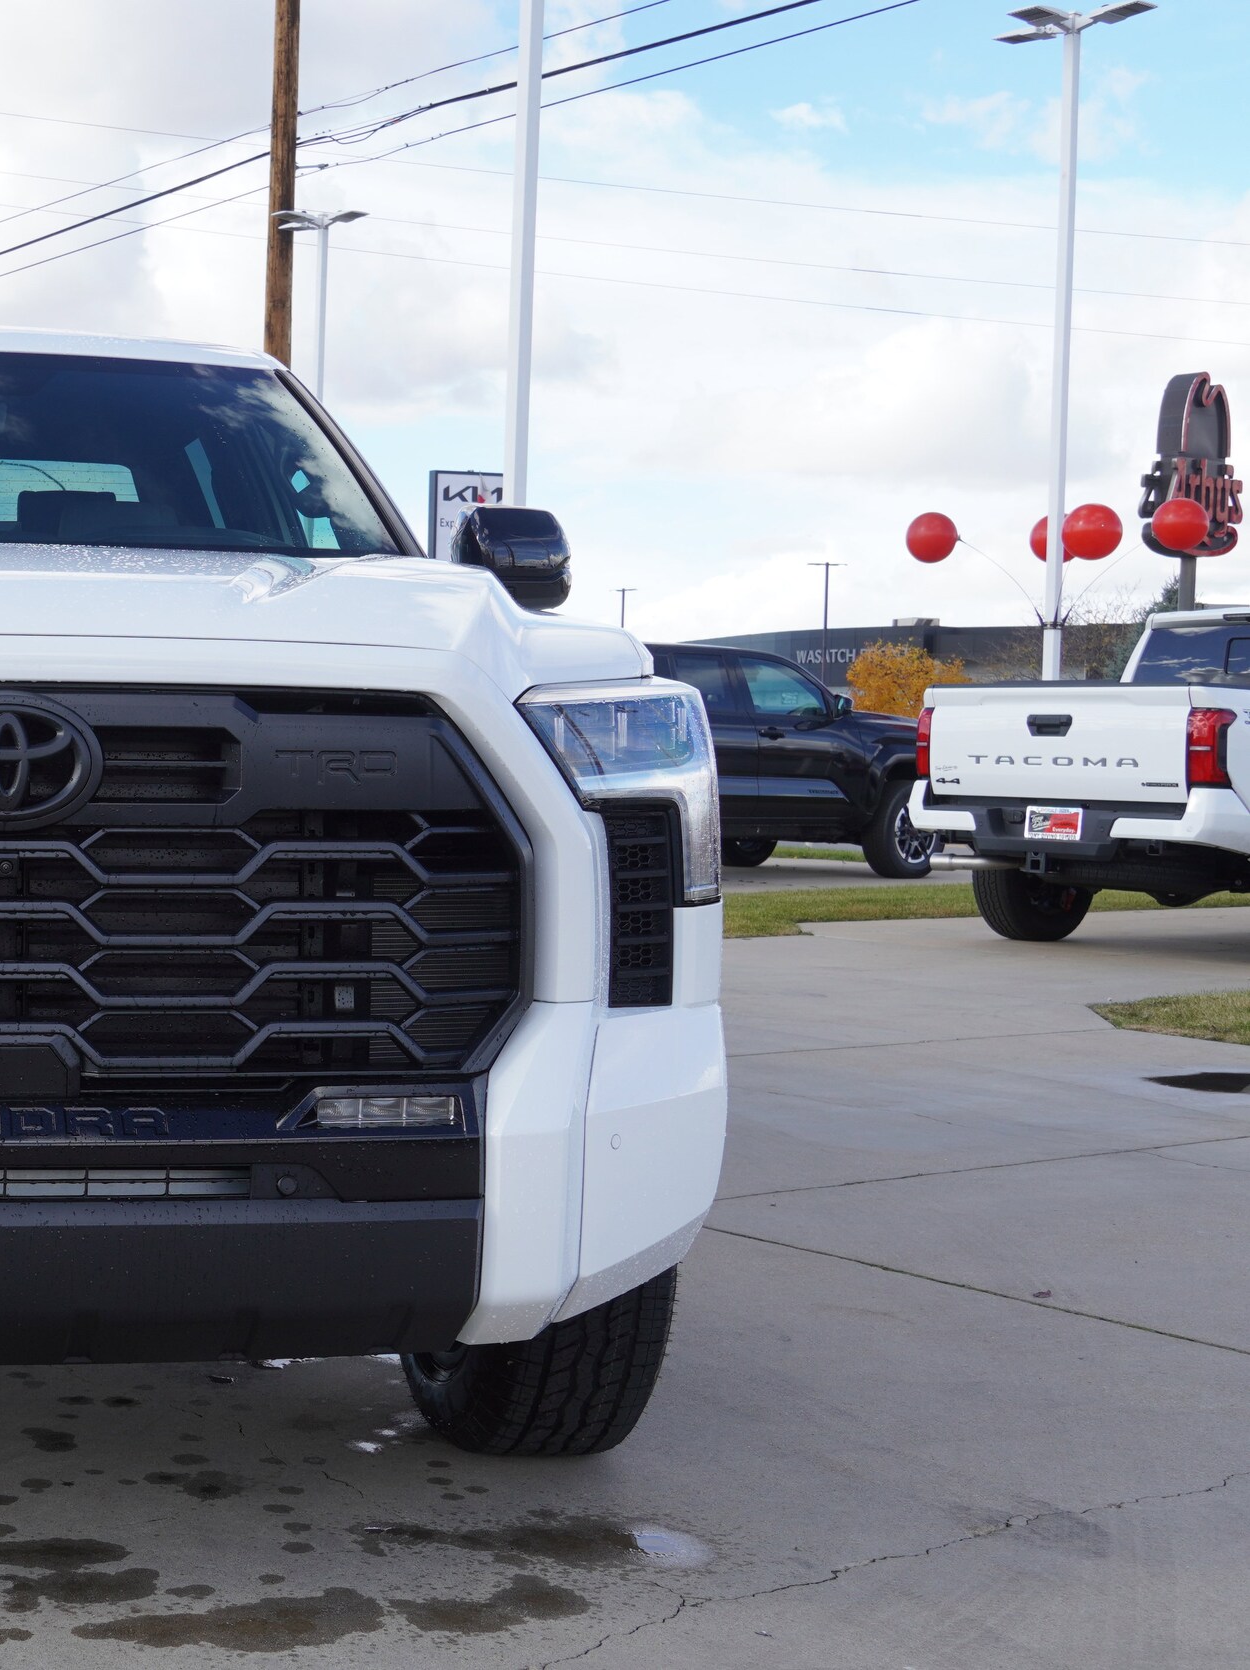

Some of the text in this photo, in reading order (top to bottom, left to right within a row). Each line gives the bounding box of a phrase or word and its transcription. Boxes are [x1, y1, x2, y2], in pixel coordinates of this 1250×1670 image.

[796, 649, 855, 663] WASATCH
[274, 750, 397, 786] TRD
[968, 755, 1139, 767] TACOMA
